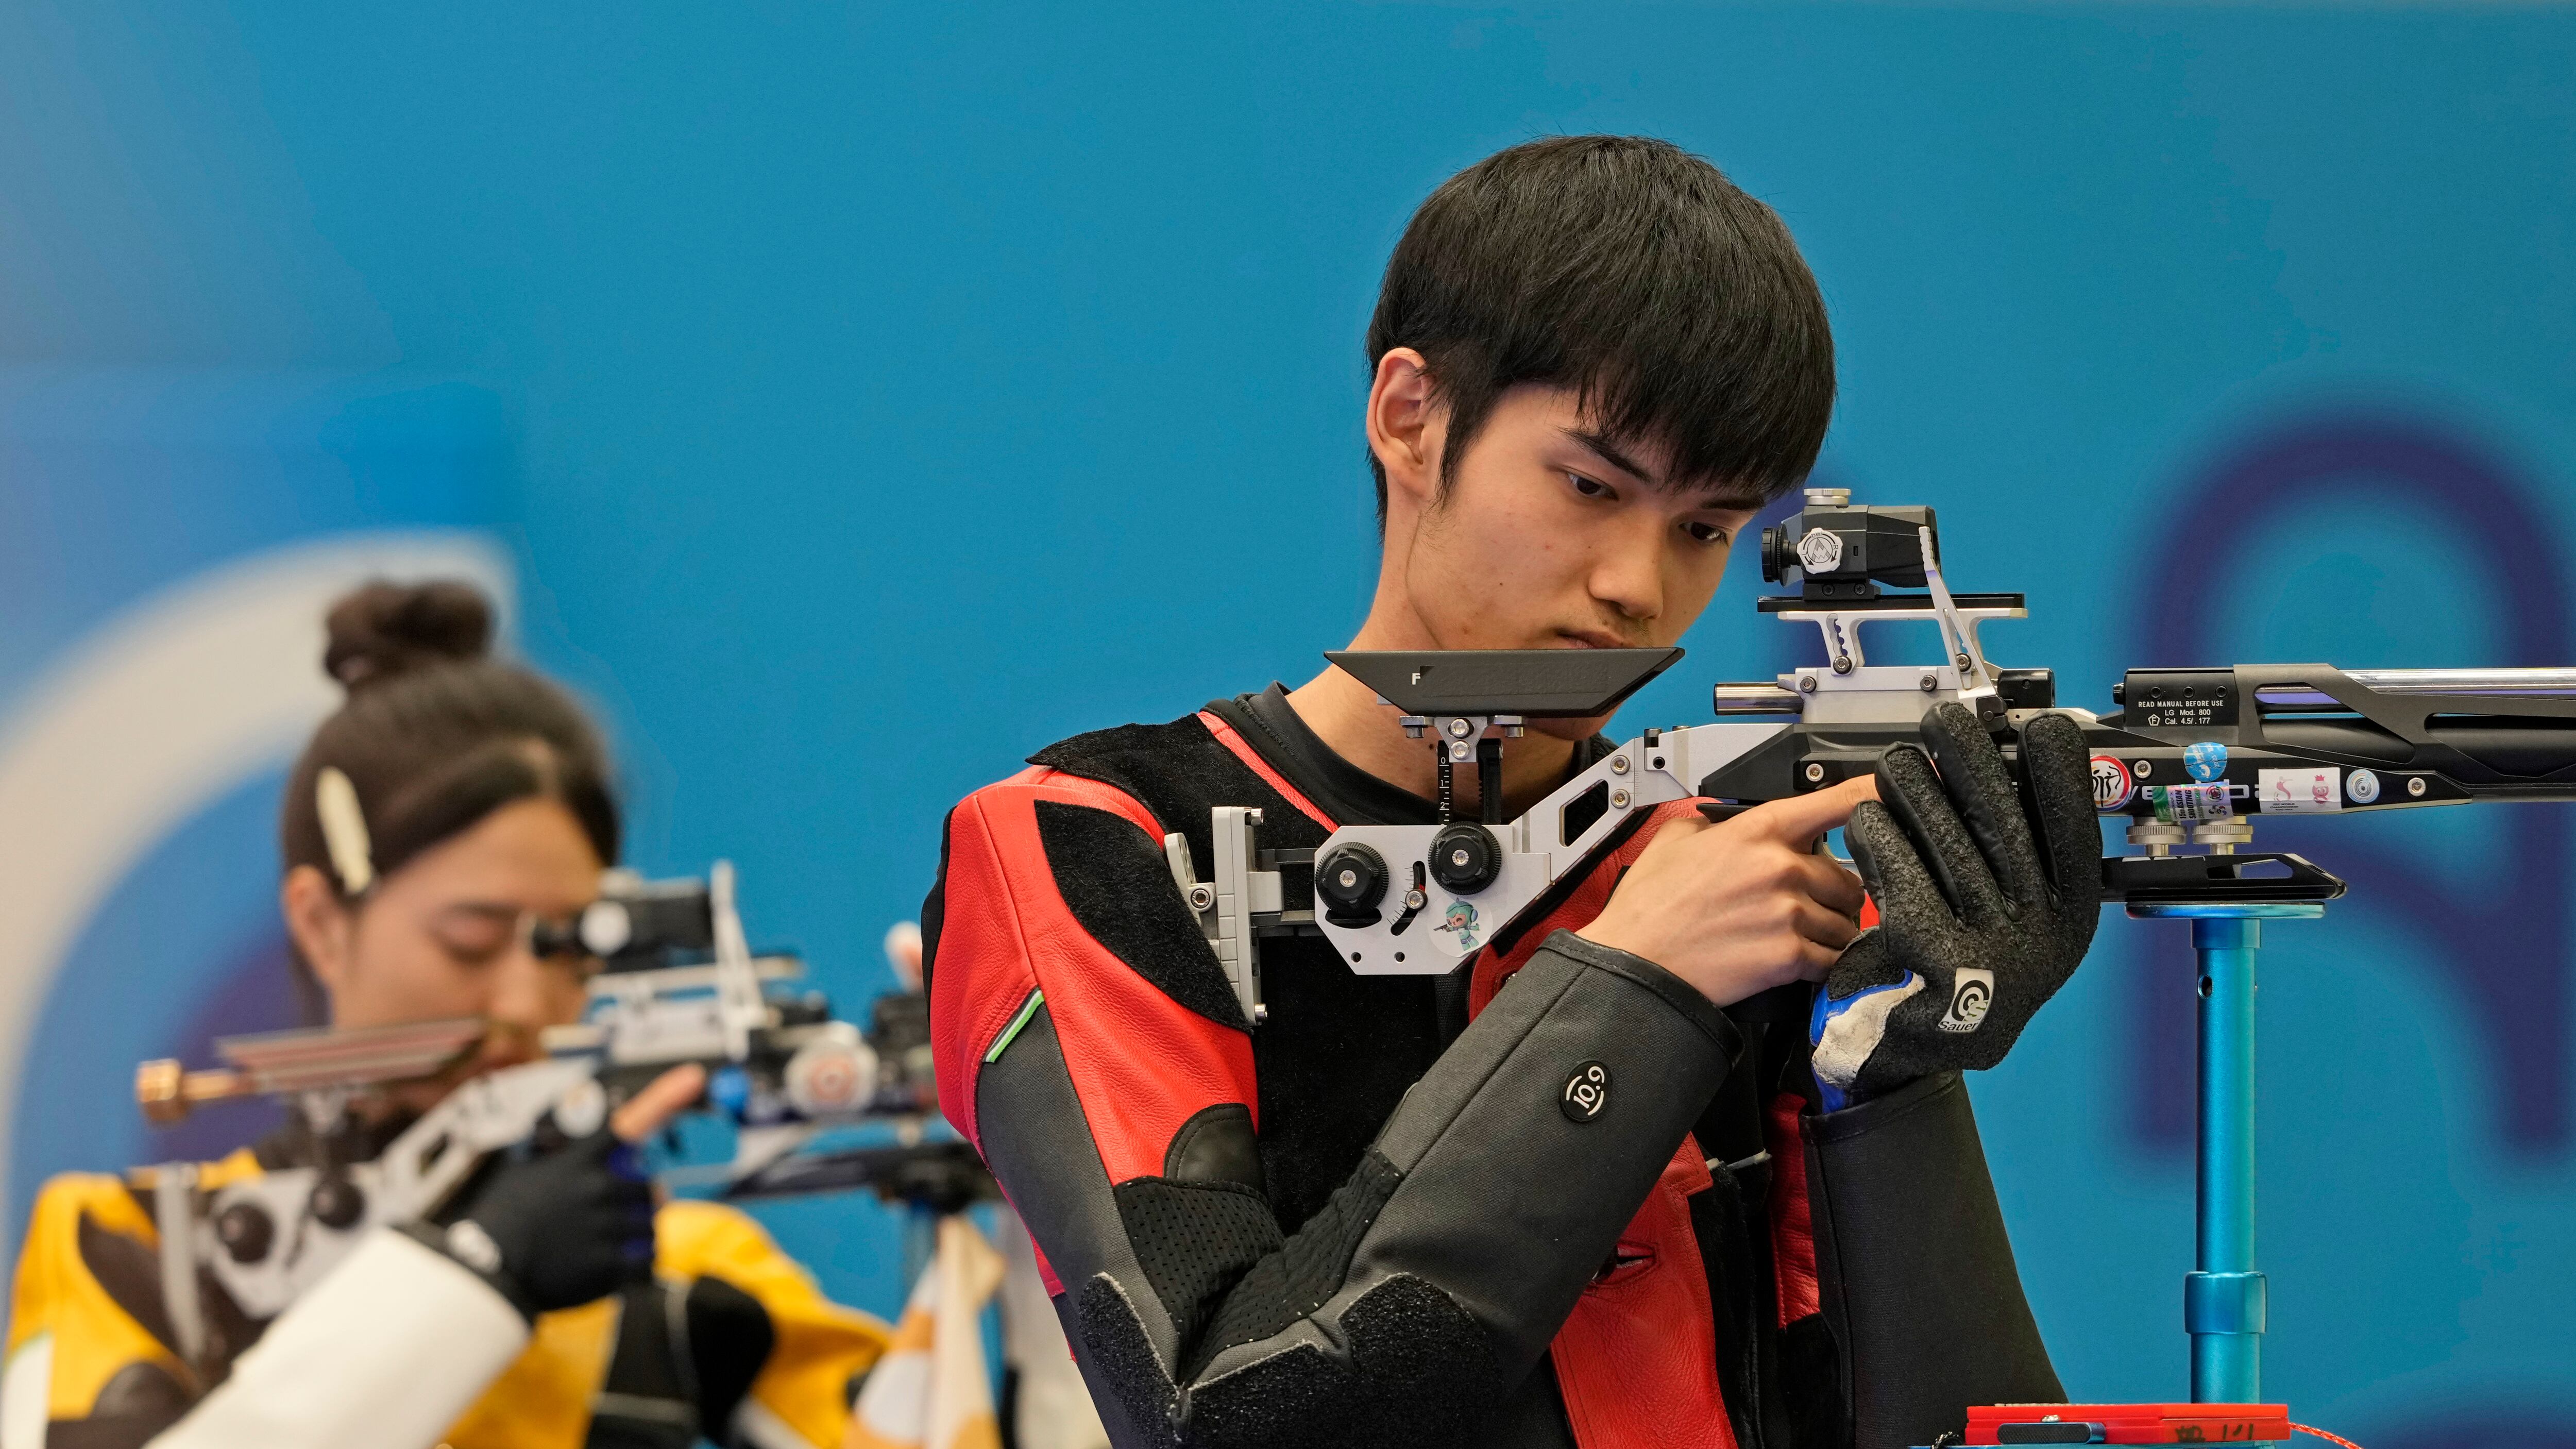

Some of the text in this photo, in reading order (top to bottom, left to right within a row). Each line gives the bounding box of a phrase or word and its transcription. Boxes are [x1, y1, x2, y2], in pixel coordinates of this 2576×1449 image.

[1412, 672, 1421, 685] F
[2175, 789, 2184, 808] ASIAN
[2185, 789, 2196, 819] SHOOTING
[1938, 1021, 1979, 1031] Sauer
